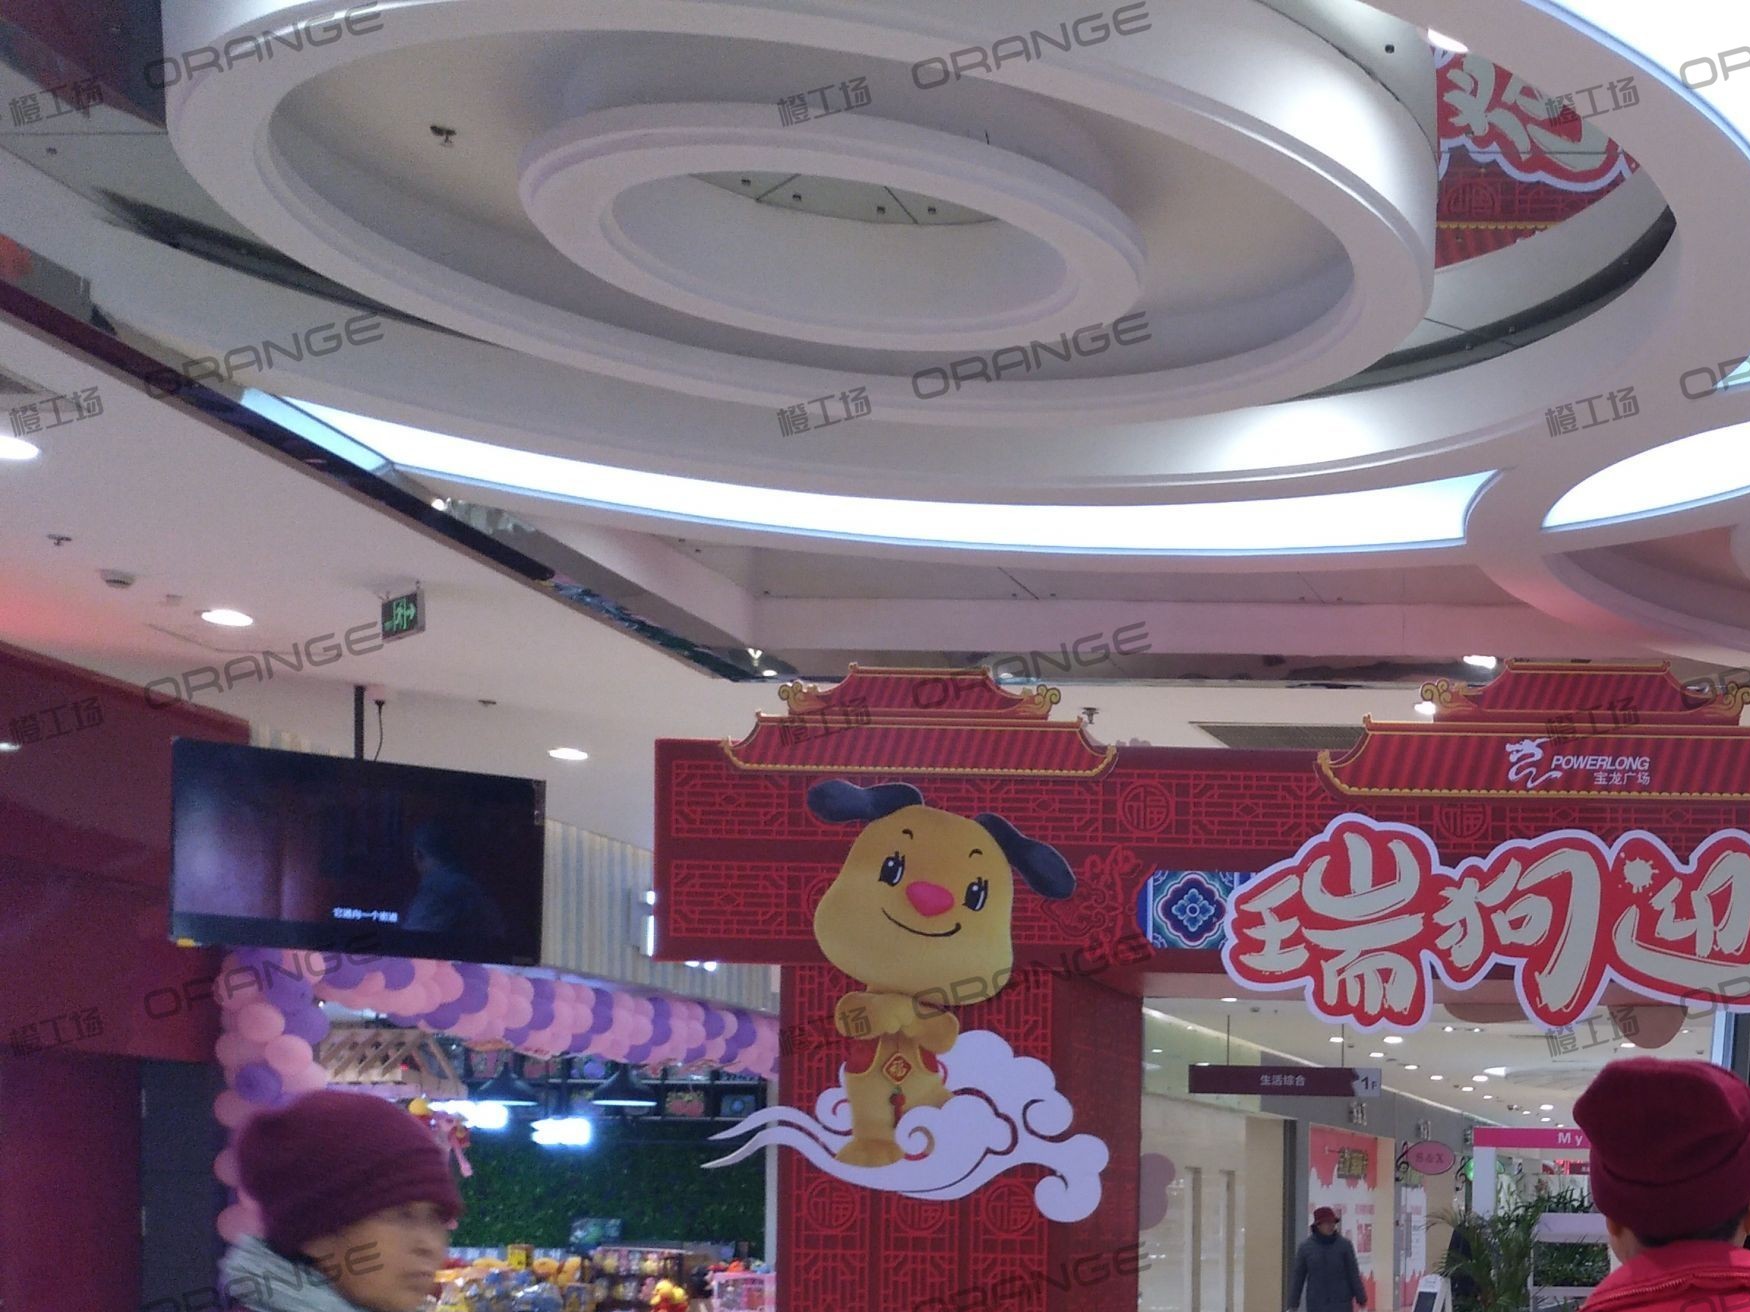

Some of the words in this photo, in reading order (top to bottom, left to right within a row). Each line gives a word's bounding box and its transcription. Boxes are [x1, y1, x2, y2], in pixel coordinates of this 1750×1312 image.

[1551, 755, 1650, 770] POWERLONG
[1594, 772, 1650, 785] 宝龙广场
